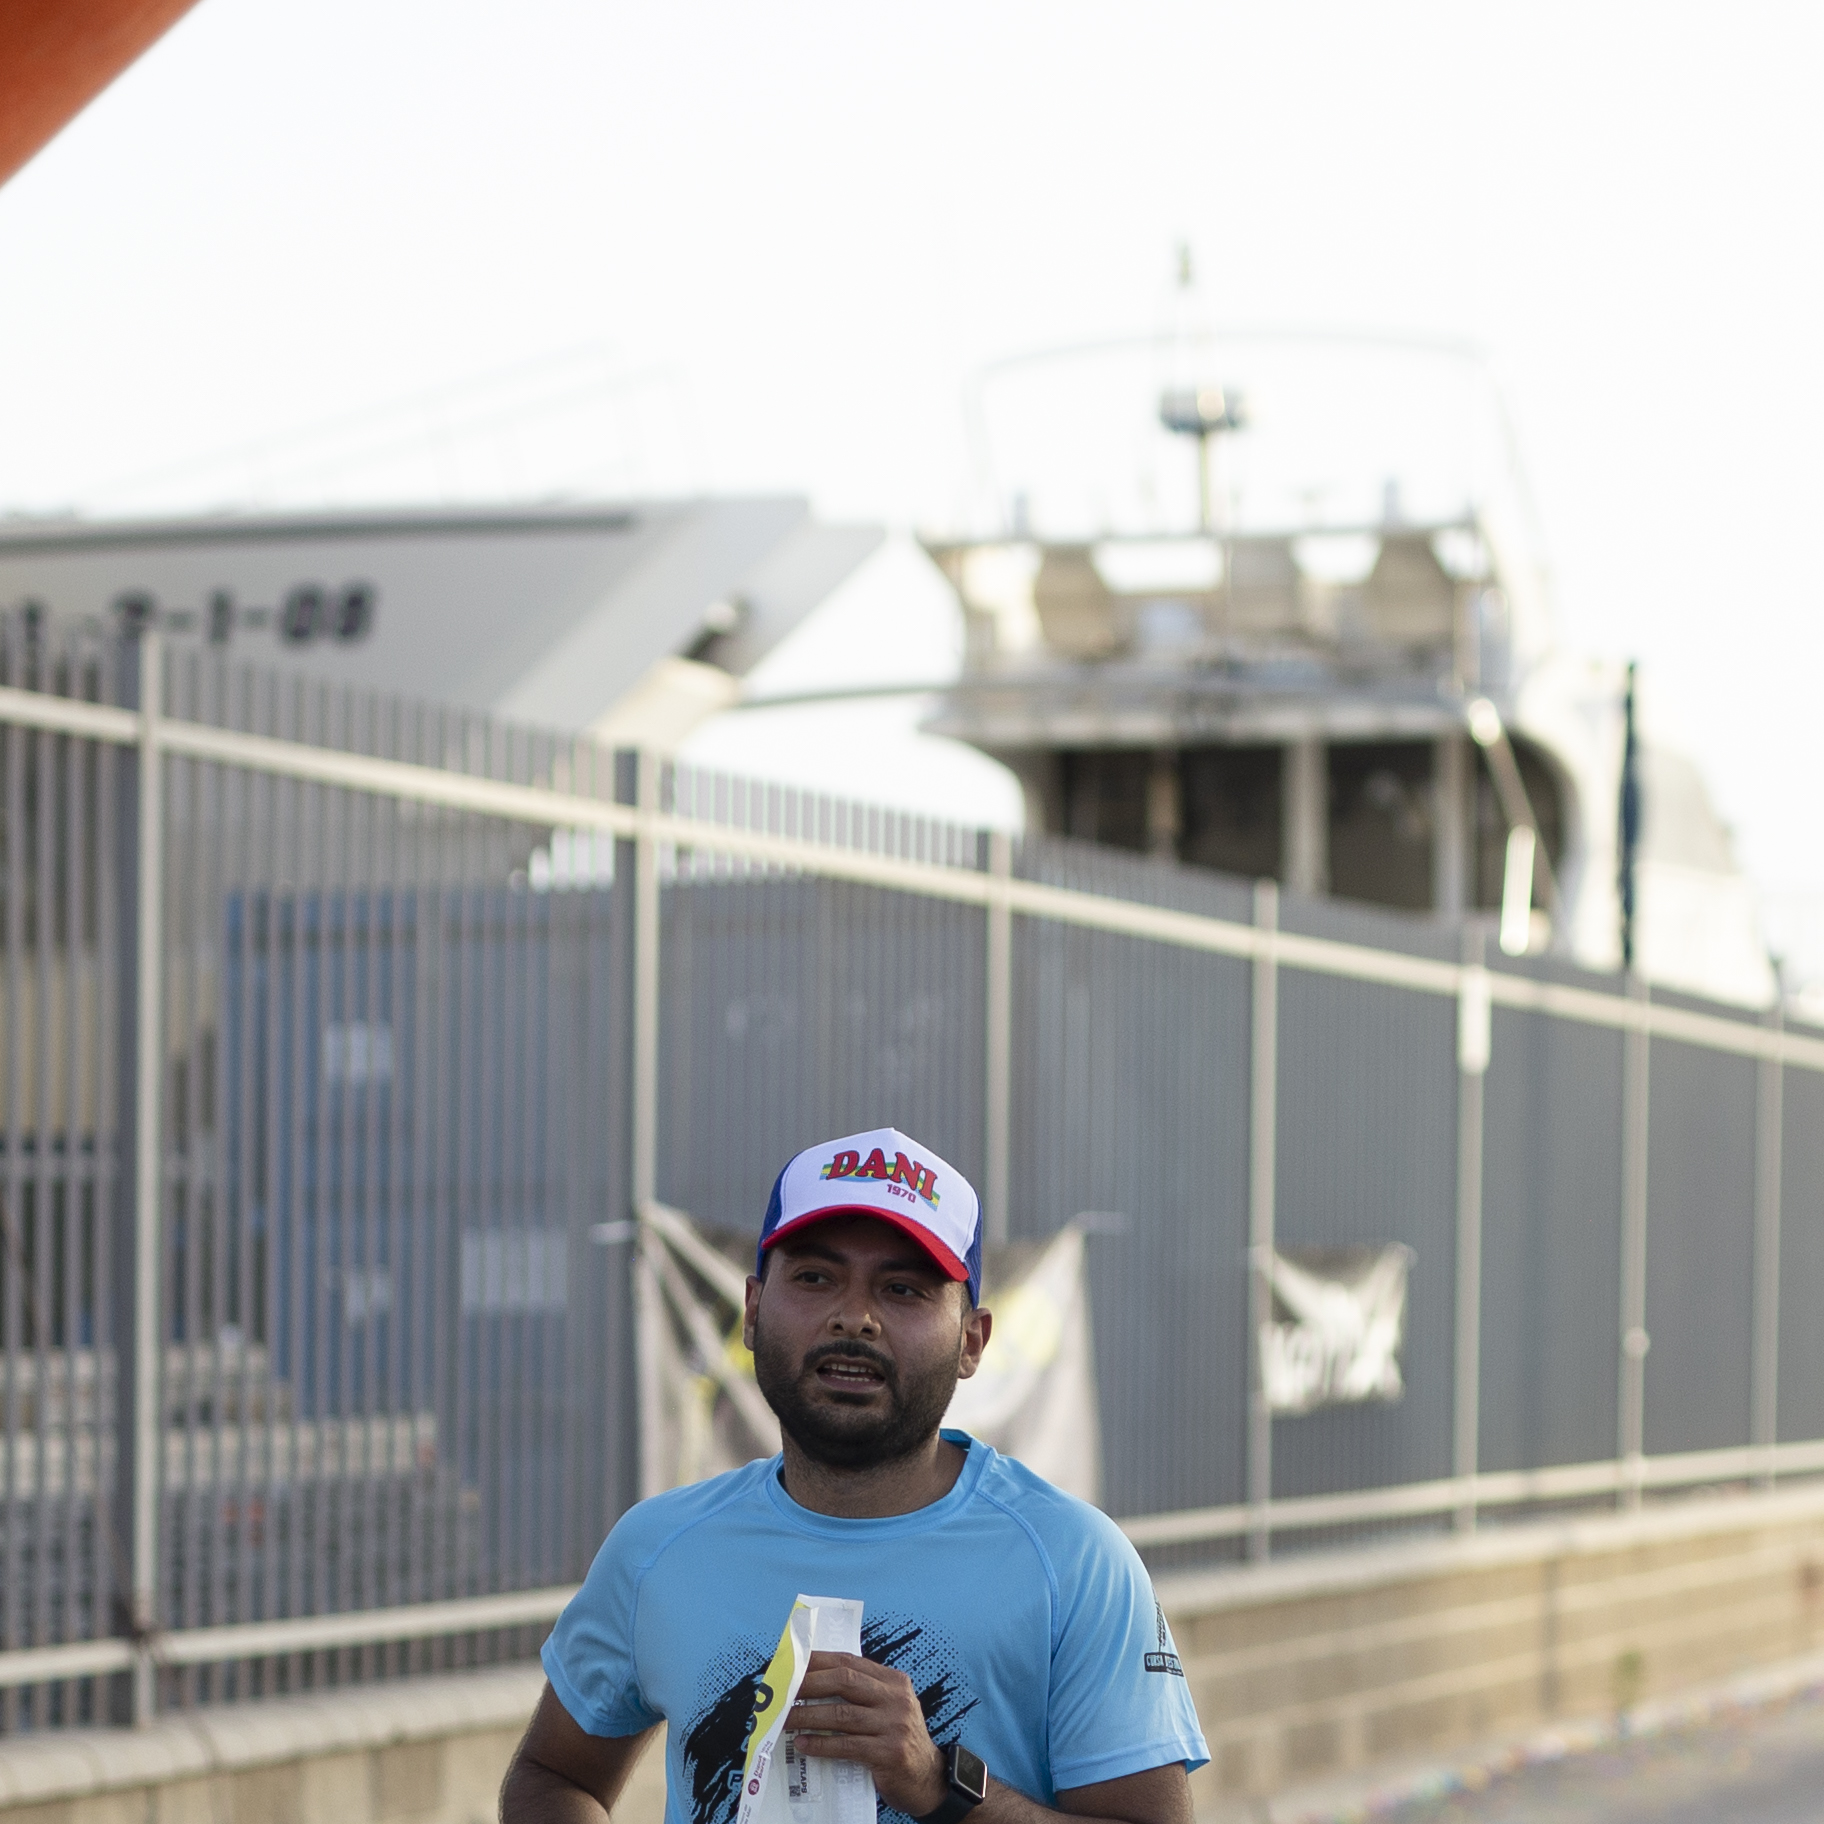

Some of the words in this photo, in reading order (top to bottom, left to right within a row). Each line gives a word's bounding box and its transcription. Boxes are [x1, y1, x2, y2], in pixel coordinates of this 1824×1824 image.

[826, 1147, 938, 1201] DANI
[886, 1183, 917, 1204] 1970
[799, 1757, 808, 1794] MYLAPS
